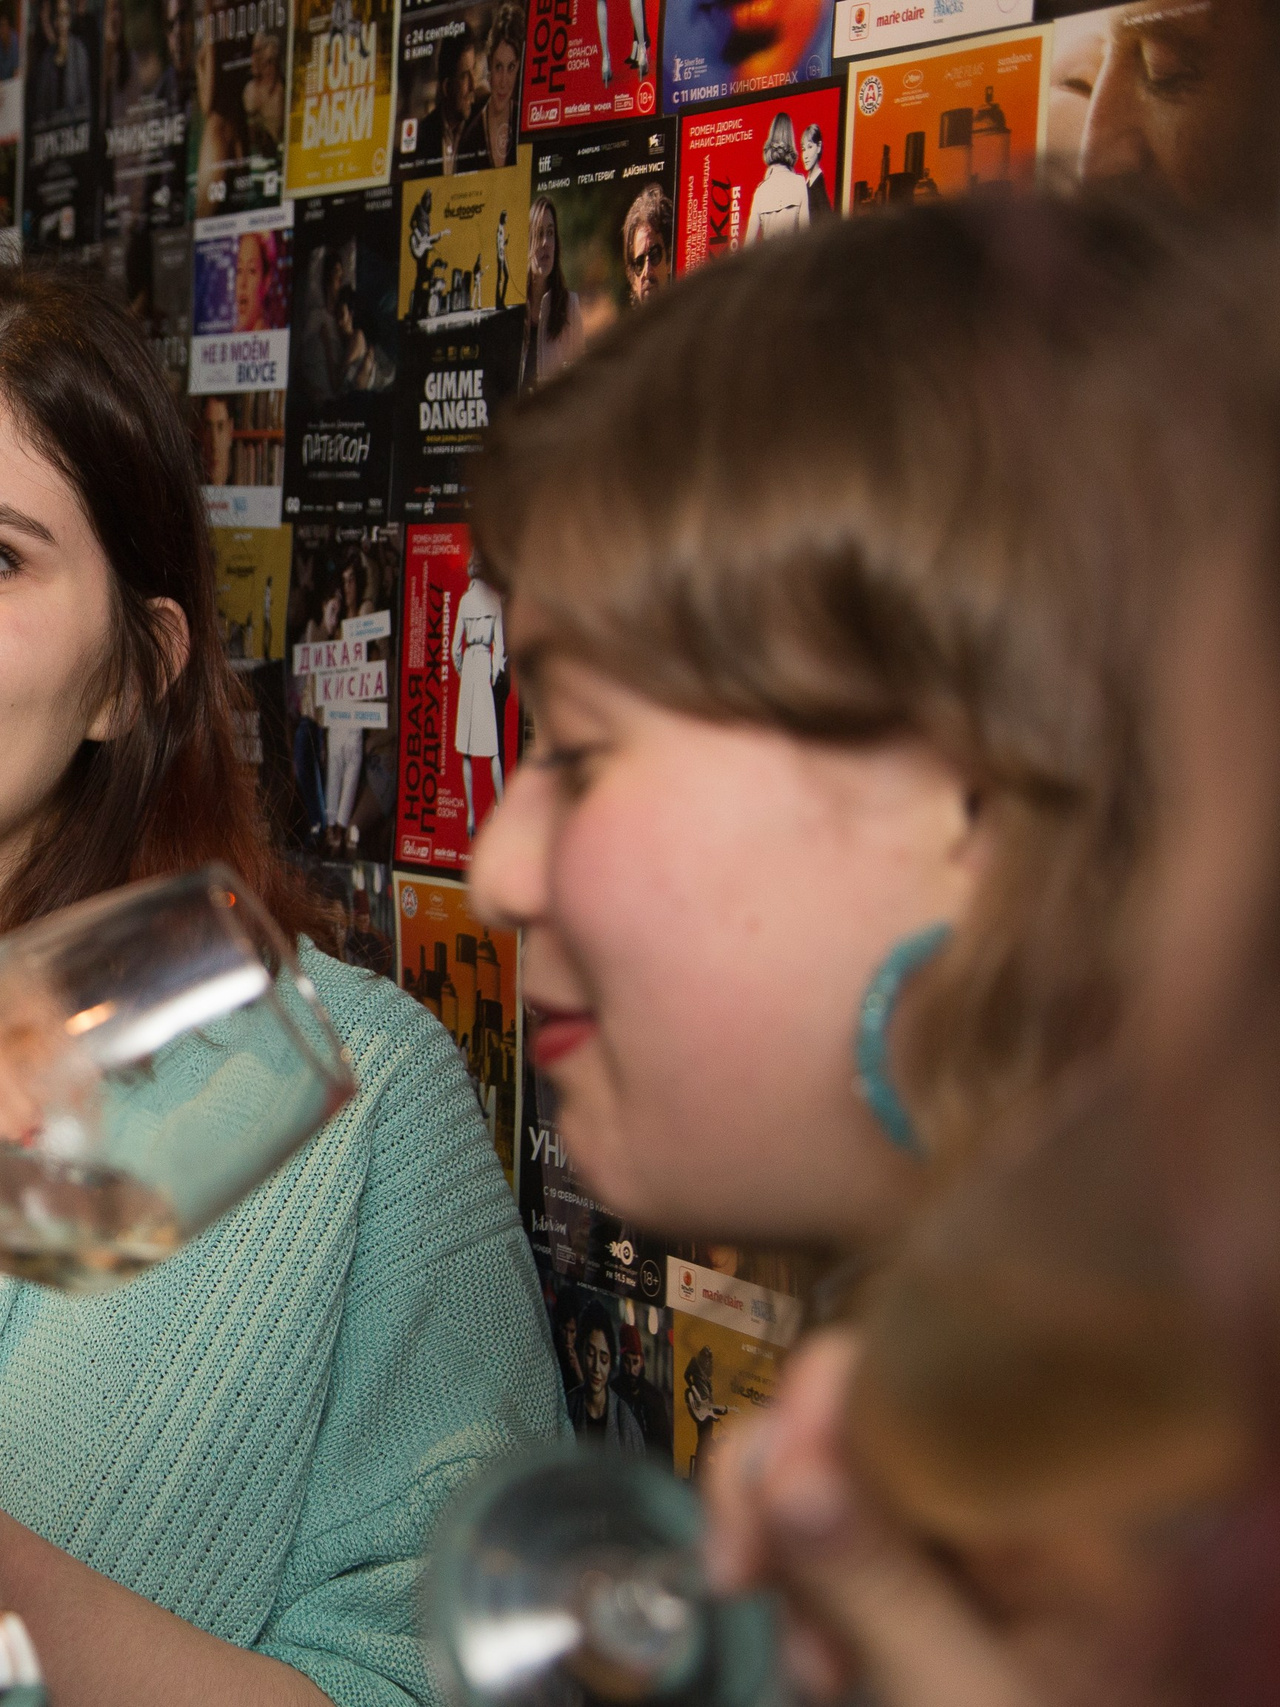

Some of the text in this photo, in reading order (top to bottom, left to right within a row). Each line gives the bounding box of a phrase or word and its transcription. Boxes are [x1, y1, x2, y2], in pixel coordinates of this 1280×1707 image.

[876, 6, 925, 27] marie claire
[411, 26, 424, 44] 24
[424, 21, 466, 42] сентября
[320, 21, 377, 93] ГОНИ
[567, 45, 598, 59] ФРАНСУА
[567, 58, 590, 71] ОЗОНА
[640, 91, 653, 105] 18+
[681, 90, 689, 103] 11
[690, 85, 719, 101] ИЮНЯ
[721, 83, 728, 96] В
[729, 71, 798, 95] КИНОТЕАТРАХ
[301, 85, 376, 150] БАБКИ
[689, 118, 744, 137] РОМЕН ДЮРИС
[689, 129, 754, 150] АНАИС ДЕМУСТЬЕ
[577, 169, 616, 185] ГРЕТА ГЕРВИГ
[622, 161, 665, 179] ДАЙЭНН УИСТ
[548, 177, 570, 190] ПАЧИНО
[686, 175, 695, 234] ПЕРСОННАЗ
[730, 185, 741, 252] ОЯБРЯ
[201, 334, 270, 364] НЕ В МОЁМ
[237, 361, 276, 384] ВКУСЕ
[424, 369, 484, 401] GIMME
[419, 399, 489, 430] DANGER
[302, 431, 371, 467] ПАТЕРСОН
[442, 591, 451, 662] НОЯБРЯ
[300, 642, 363, 672] ДИКАЯ
[441, 664, 449, 681] 13
[322, 671, 385, 700] КИСКА
[404, 674, 421, 820] НОВАЯ
[543, 1185, 549, 1196] С
[549, 1187, 557, 1198] 19
[557, 1190, 589, 1208] ФЕВРАЛЯ
[590, 1199, 594, 1209] В
[643, 1270, 659, 1286] 18+
[702, 1289, 723, 1303] marie
